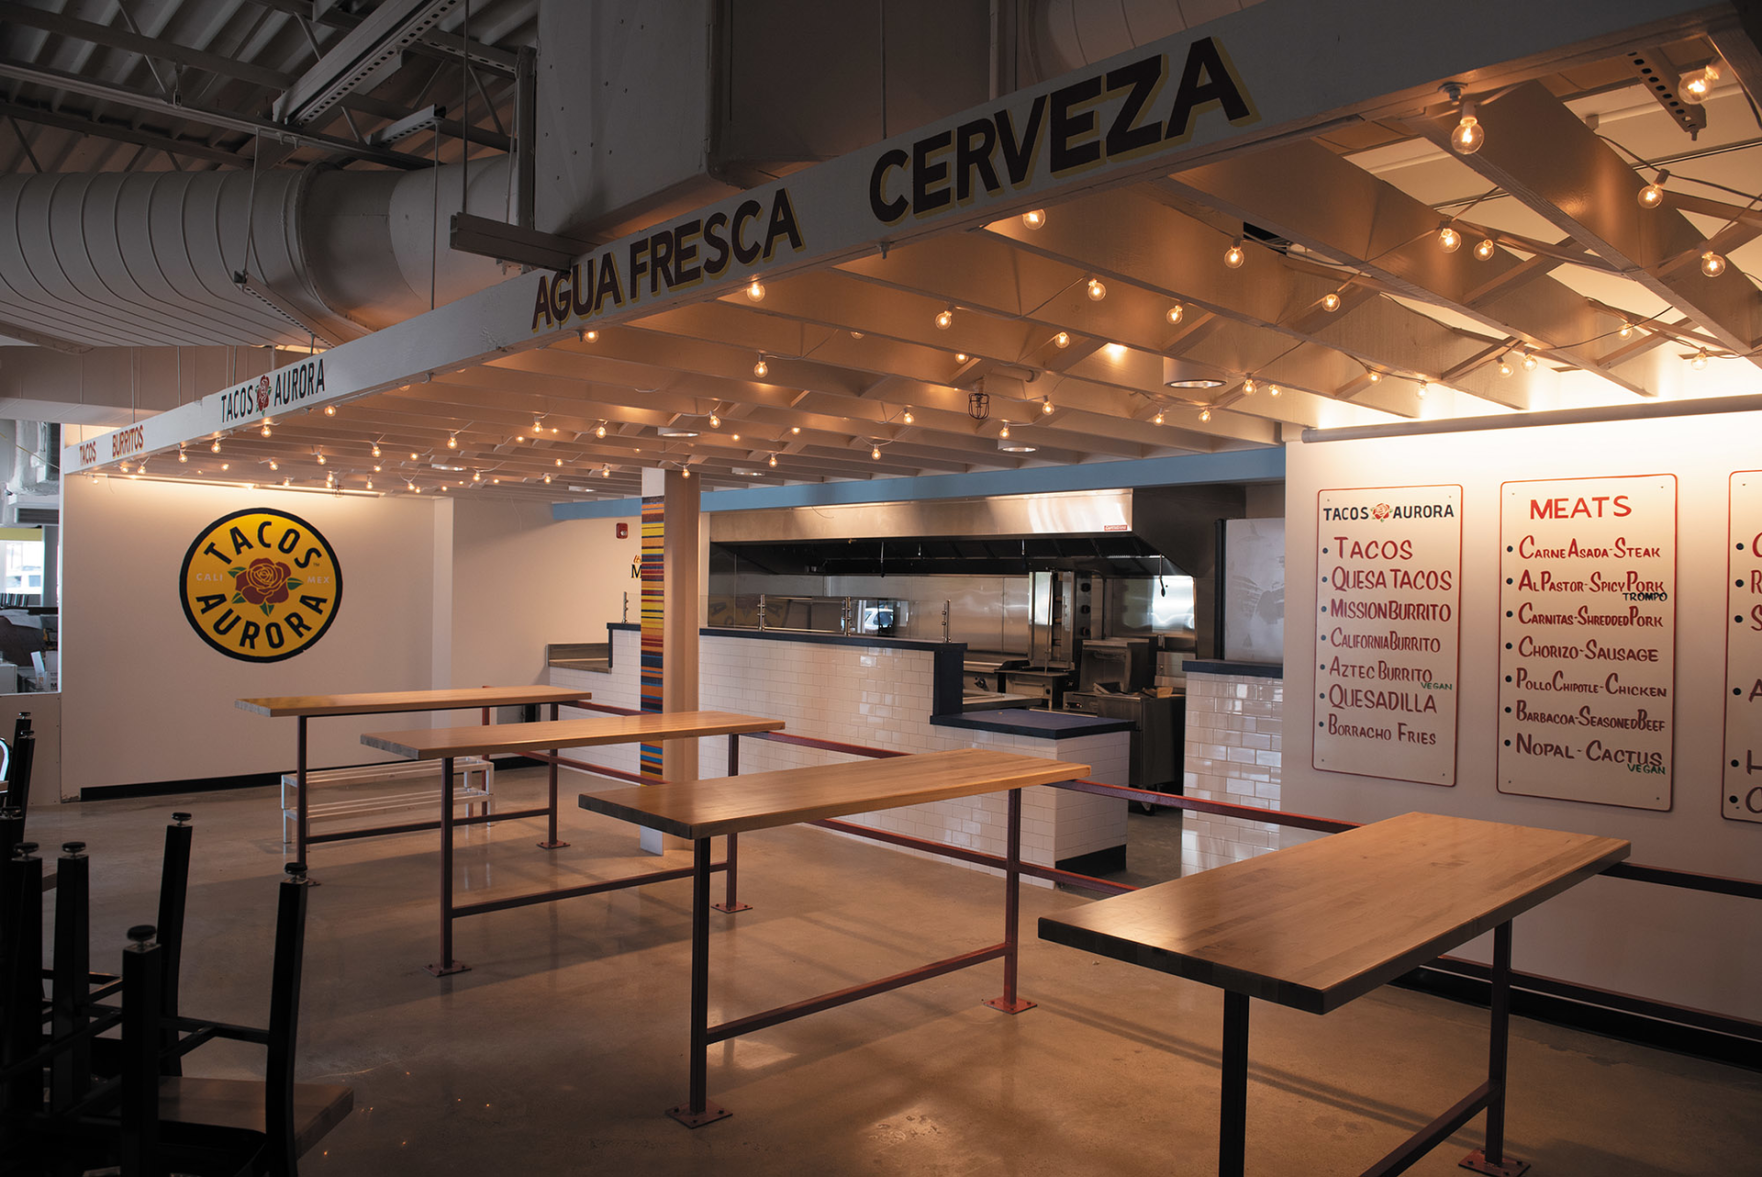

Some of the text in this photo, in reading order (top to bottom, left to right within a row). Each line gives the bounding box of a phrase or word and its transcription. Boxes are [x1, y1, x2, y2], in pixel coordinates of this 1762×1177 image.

[869, 36, 1262, 227] CERVEZA
[531, 188, 806, 333] AGUA FRESCA
[221, 358, 325, 423] TACOS AURORA
[80, 425, 144, 465] TACOS BURRITOS
[1323, 504, 1455, 521] TACOS AURORA
[1530, 495, 1632, 520] MEATS
[204, 521, 322, 569] TACOS
[1334, 536, 1413, 560] TACOS
[1519, 535, 1566, 559] CARNE
[196, 572, 330, 584] CALI MEX
[1331, 566, 1453, 592] QUESA TACOS
[1626, 570, 1664, 593] PORK
[1622, 592, 1668, 602] TROMPO
[195, 593, 328, 650] AURORA
[1329, 655, 1433, 683] AZTEC BURRITO
[1516, 667, 1552, 691] POLLO
[1329, 683, 1437, 714] QUESADILLA
[1421, 682, 1453, 690] VEGAN
[1328, 713, 1436, 745] BORRACHO FRIES
[1627, 763, 1666, 775] VEGAN
